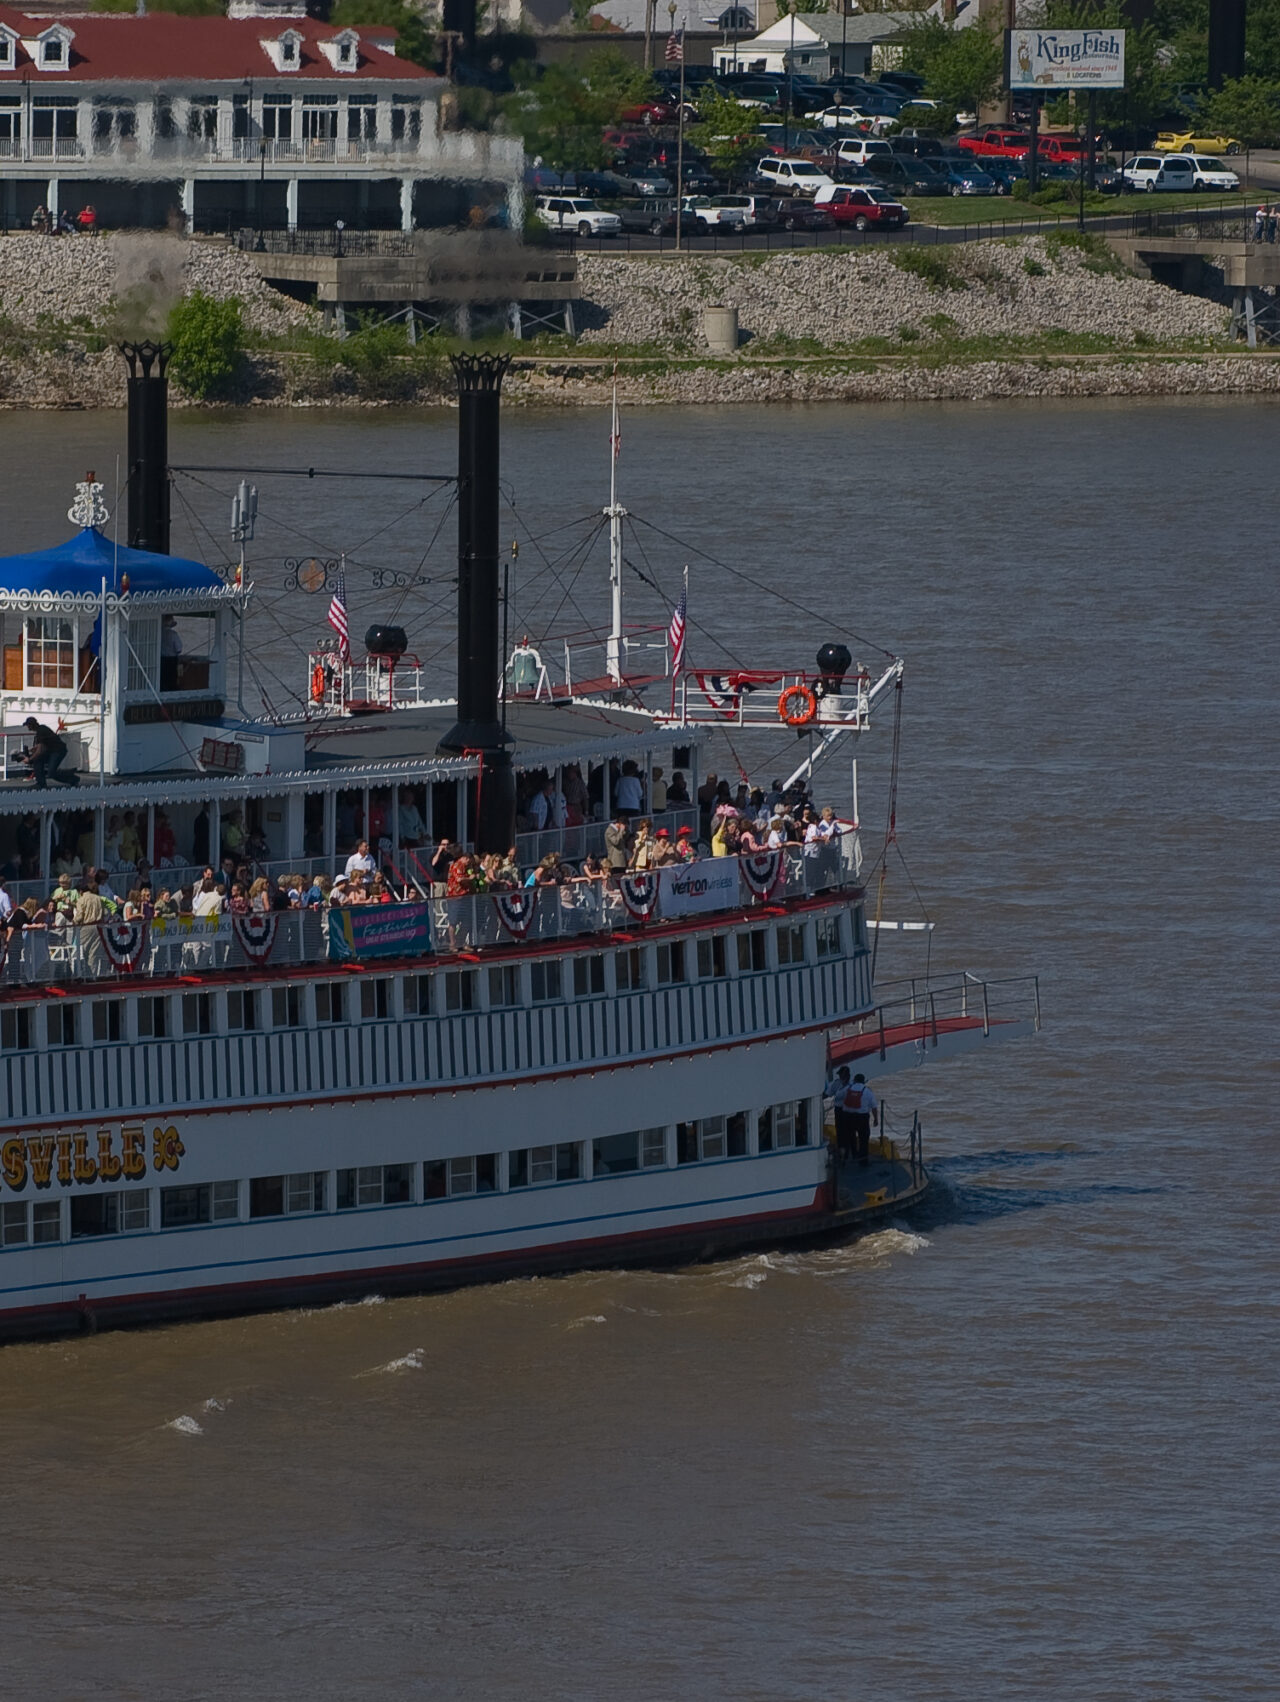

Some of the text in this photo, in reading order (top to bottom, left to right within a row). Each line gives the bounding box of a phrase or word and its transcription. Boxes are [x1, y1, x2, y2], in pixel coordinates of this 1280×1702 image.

[1037, 31, 1120, 65] KingFish
[672, 876, 733, 896] verizon wireless
[363, 916, 417, 937] Festival
